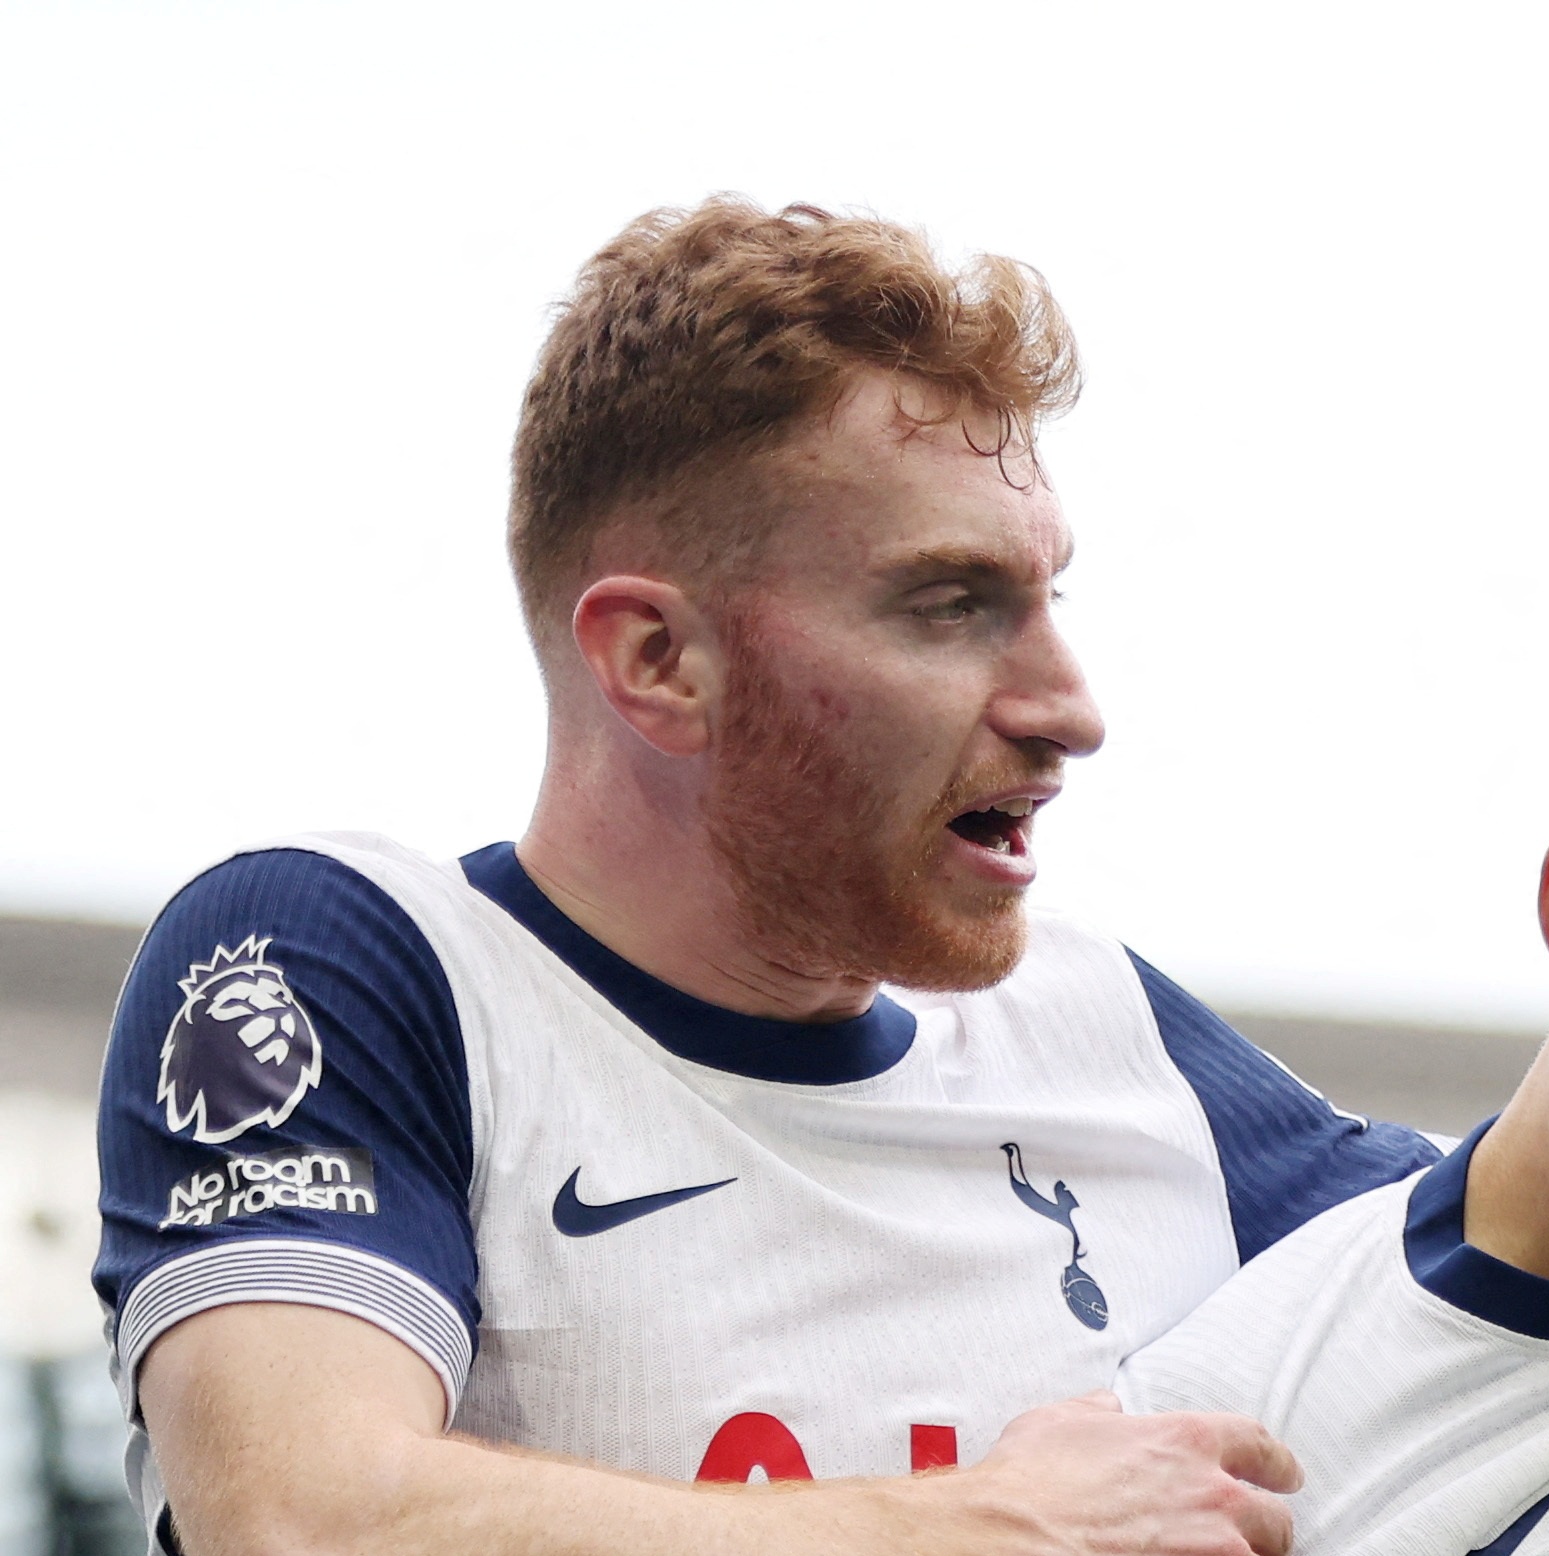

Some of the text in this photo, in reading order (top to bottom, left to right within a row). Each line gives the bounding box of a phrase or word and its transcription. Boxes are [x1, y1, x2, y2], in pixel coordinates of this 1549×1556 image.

[169, 1154, 350, 1219] No room
[228, 1183, 377, 1217] racism
